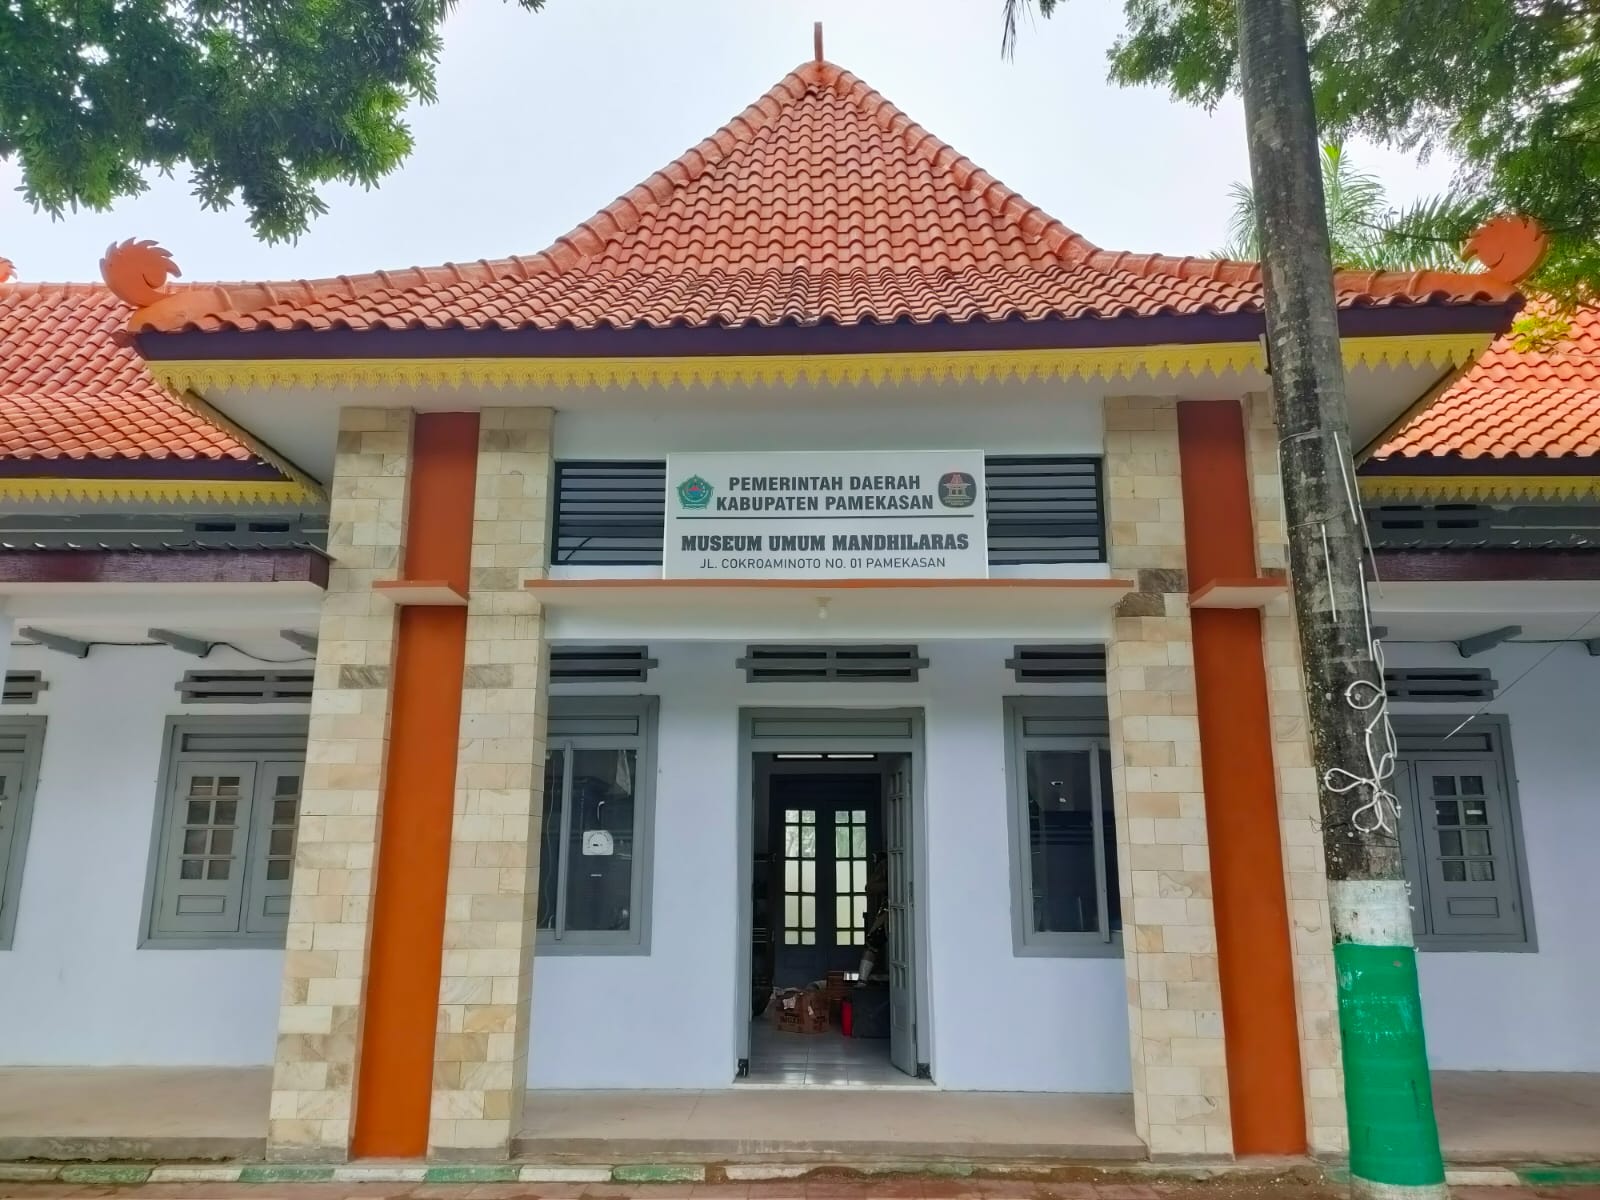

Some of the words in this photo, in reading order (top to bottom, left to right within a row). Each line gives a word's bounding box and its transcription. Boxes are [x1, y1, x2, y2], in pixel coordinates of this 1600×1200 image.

[729, 476, 842, 491] PEMERINTAH
[849, 475, 920, 490] DAERAH
[716, 496, 818, 511] KABUPATEN
[825, 494, 933, 510] PAMEKASAN
[681, 535, 762, 552] MUSEUM
[768, 535, 825, 551] UMUM
[832, 533, 969, 551] MANDHILARAS
[699, 558, 718, 569] JL.
[721, 558, 821, 569] COKROAMINOTO
[825, 558, 847, 569] NO.
[850, 558, 862, 569] 01
[866, 557, 946, 568] PAMEKASAN
